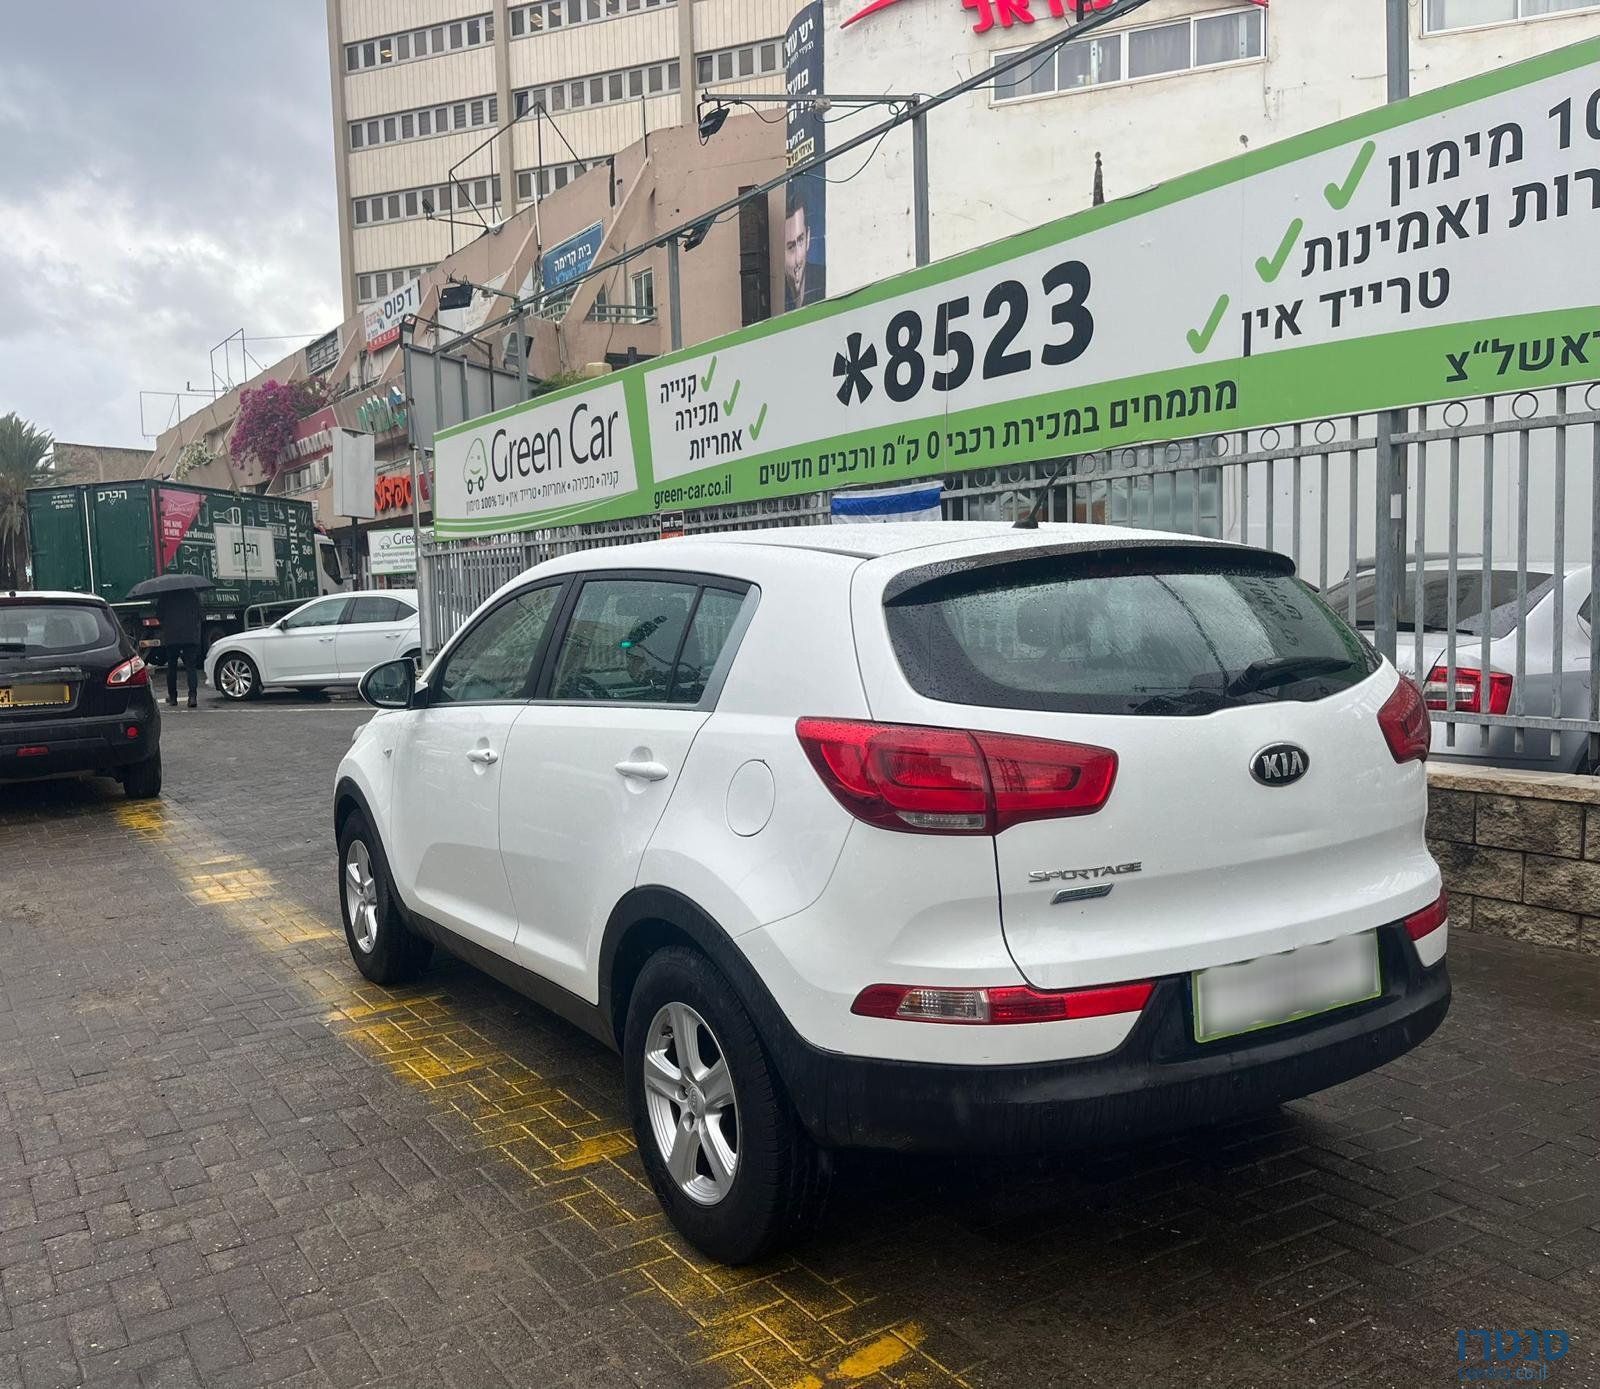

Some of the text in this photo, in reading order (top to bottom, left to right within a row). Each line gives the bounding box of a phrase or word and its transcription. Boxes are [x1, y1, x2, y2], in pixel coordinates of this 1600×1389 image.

[1389, 122, 1523, 207] מימון
[1301, 193, 1490, 278] ואמינות
[554, 250, 577, 273] קדימה
[578, 243, 592, 260] בית
[384, 287, 412, 319] דפוס
[1241, 267, 1451, 357] טרייד אין
[1446, 331, 1600, 383] אשל"צ
[660, 373, 697, 404] קנייה
[675, 401, 719, 432] מכירה
[759, 379, 1237, 485] מתמחים במכירת רכבי 0 ק"מ ורכבים חדשים
[491, 403, 618, 483] Green Car
[689, 429, 744, 462] אחריות
[520, 486, 537, 501] טרייד
[542, 480, 567, 498] אחריות
[572, 475, 595, 492] מכירה
[601, 470, 619, 489] קניה
[653, 474, 732, 509] green-car.co.il
[97, 490, 127, 502] הכרם
[481, 495, 498, 510] 100%
[1262, 750, 1305, 779] KIA
[1028, 861, 1143, 883] SPORTAGE
